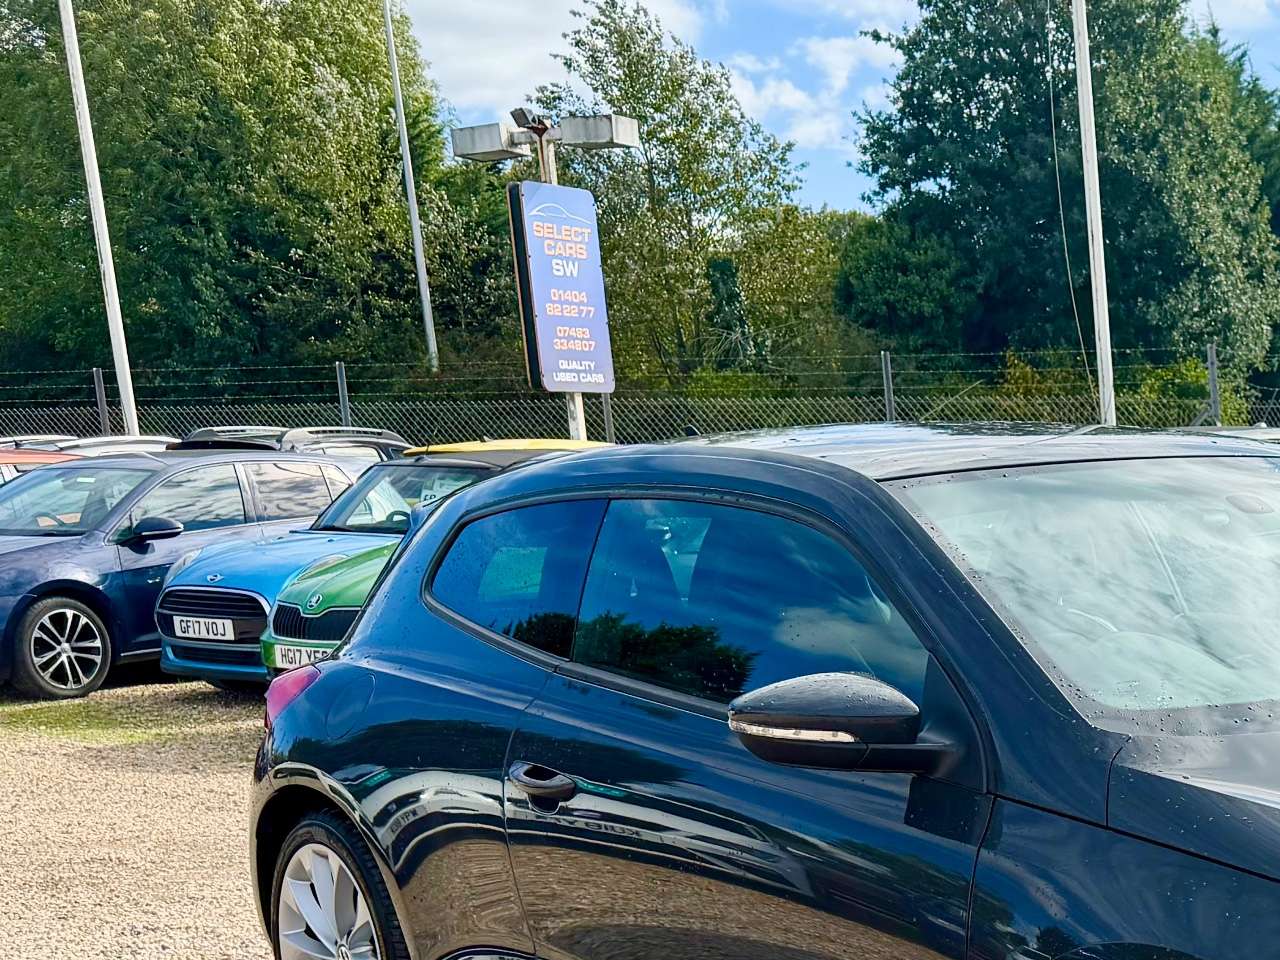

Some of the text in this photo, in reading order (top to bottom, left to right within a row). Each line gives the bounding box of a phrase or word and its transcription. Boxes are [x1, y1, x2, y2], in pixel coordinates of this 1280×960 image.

[533, 221, 592, 242] SELECT
[544, 239, 588, 259] CARS
[552, 258, 579, 277] SW
[550, 288, 588, 303] 01404
[558, 360, 596, 371] QUALITY
[553, 372, 605, 384] USED CARS
[180, 619, 226, 637] GF17 VOJ
[280, 648, 302, 666] HG17
